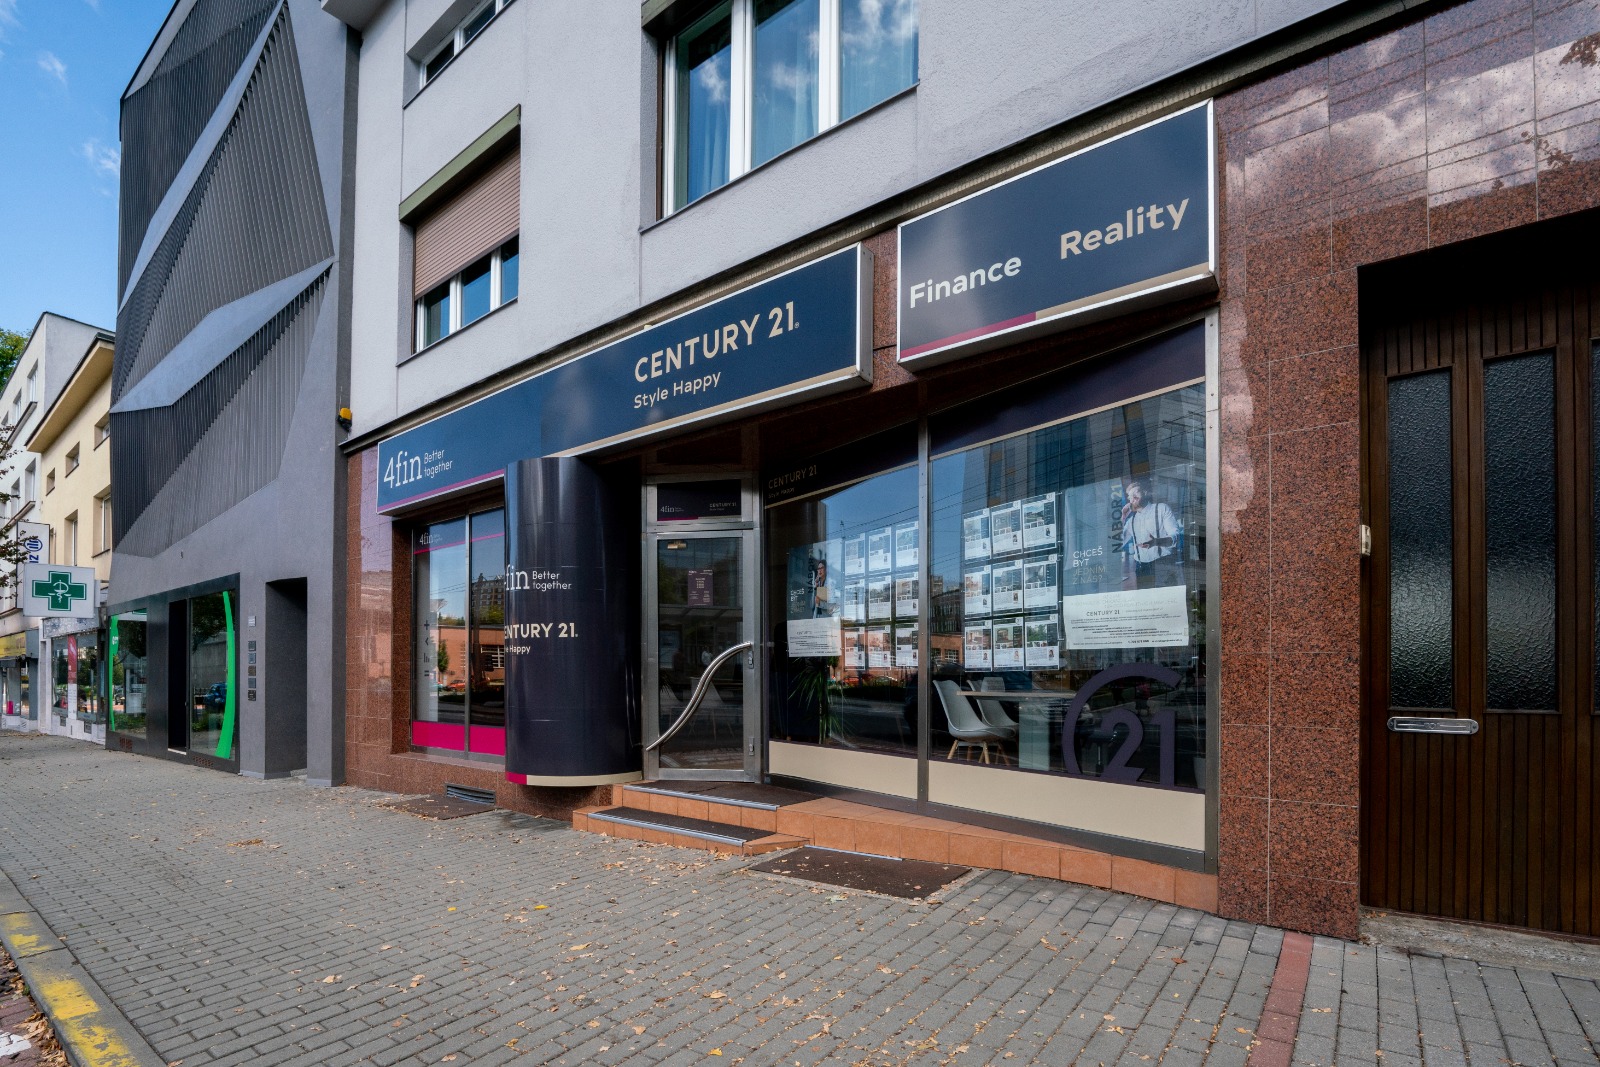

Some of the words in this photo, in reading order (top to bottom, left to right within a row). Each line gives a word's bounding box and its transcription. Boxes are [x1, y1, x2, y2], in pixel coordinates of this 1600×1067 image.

[1060, 198, 1190, 259] Reality
[910, 257, 1022, 308] Finance
[634, 314, 760, 382] CENTURY
[634, 387, 668, 409] Style
[673, 372, 721, 397] Happy
[423, 449, 445, 464] Better
[383, 450, 422, 488] 4fin
[424, 460, 453, 479] together
[768, 467, 807, 489] CENTURY
[808, 464, 817, 477] 21
[660, 505, 675, 513] 4fin
[419, 532, 434, 545] 4fin
[1073, 545, 1103, 559] CHCEŠ
[504, 564, 530, 591] fin
[532, 570, 560, 580] Better
[532, 581, 572, 592] together
[510, 645, 531, 654] Happy
